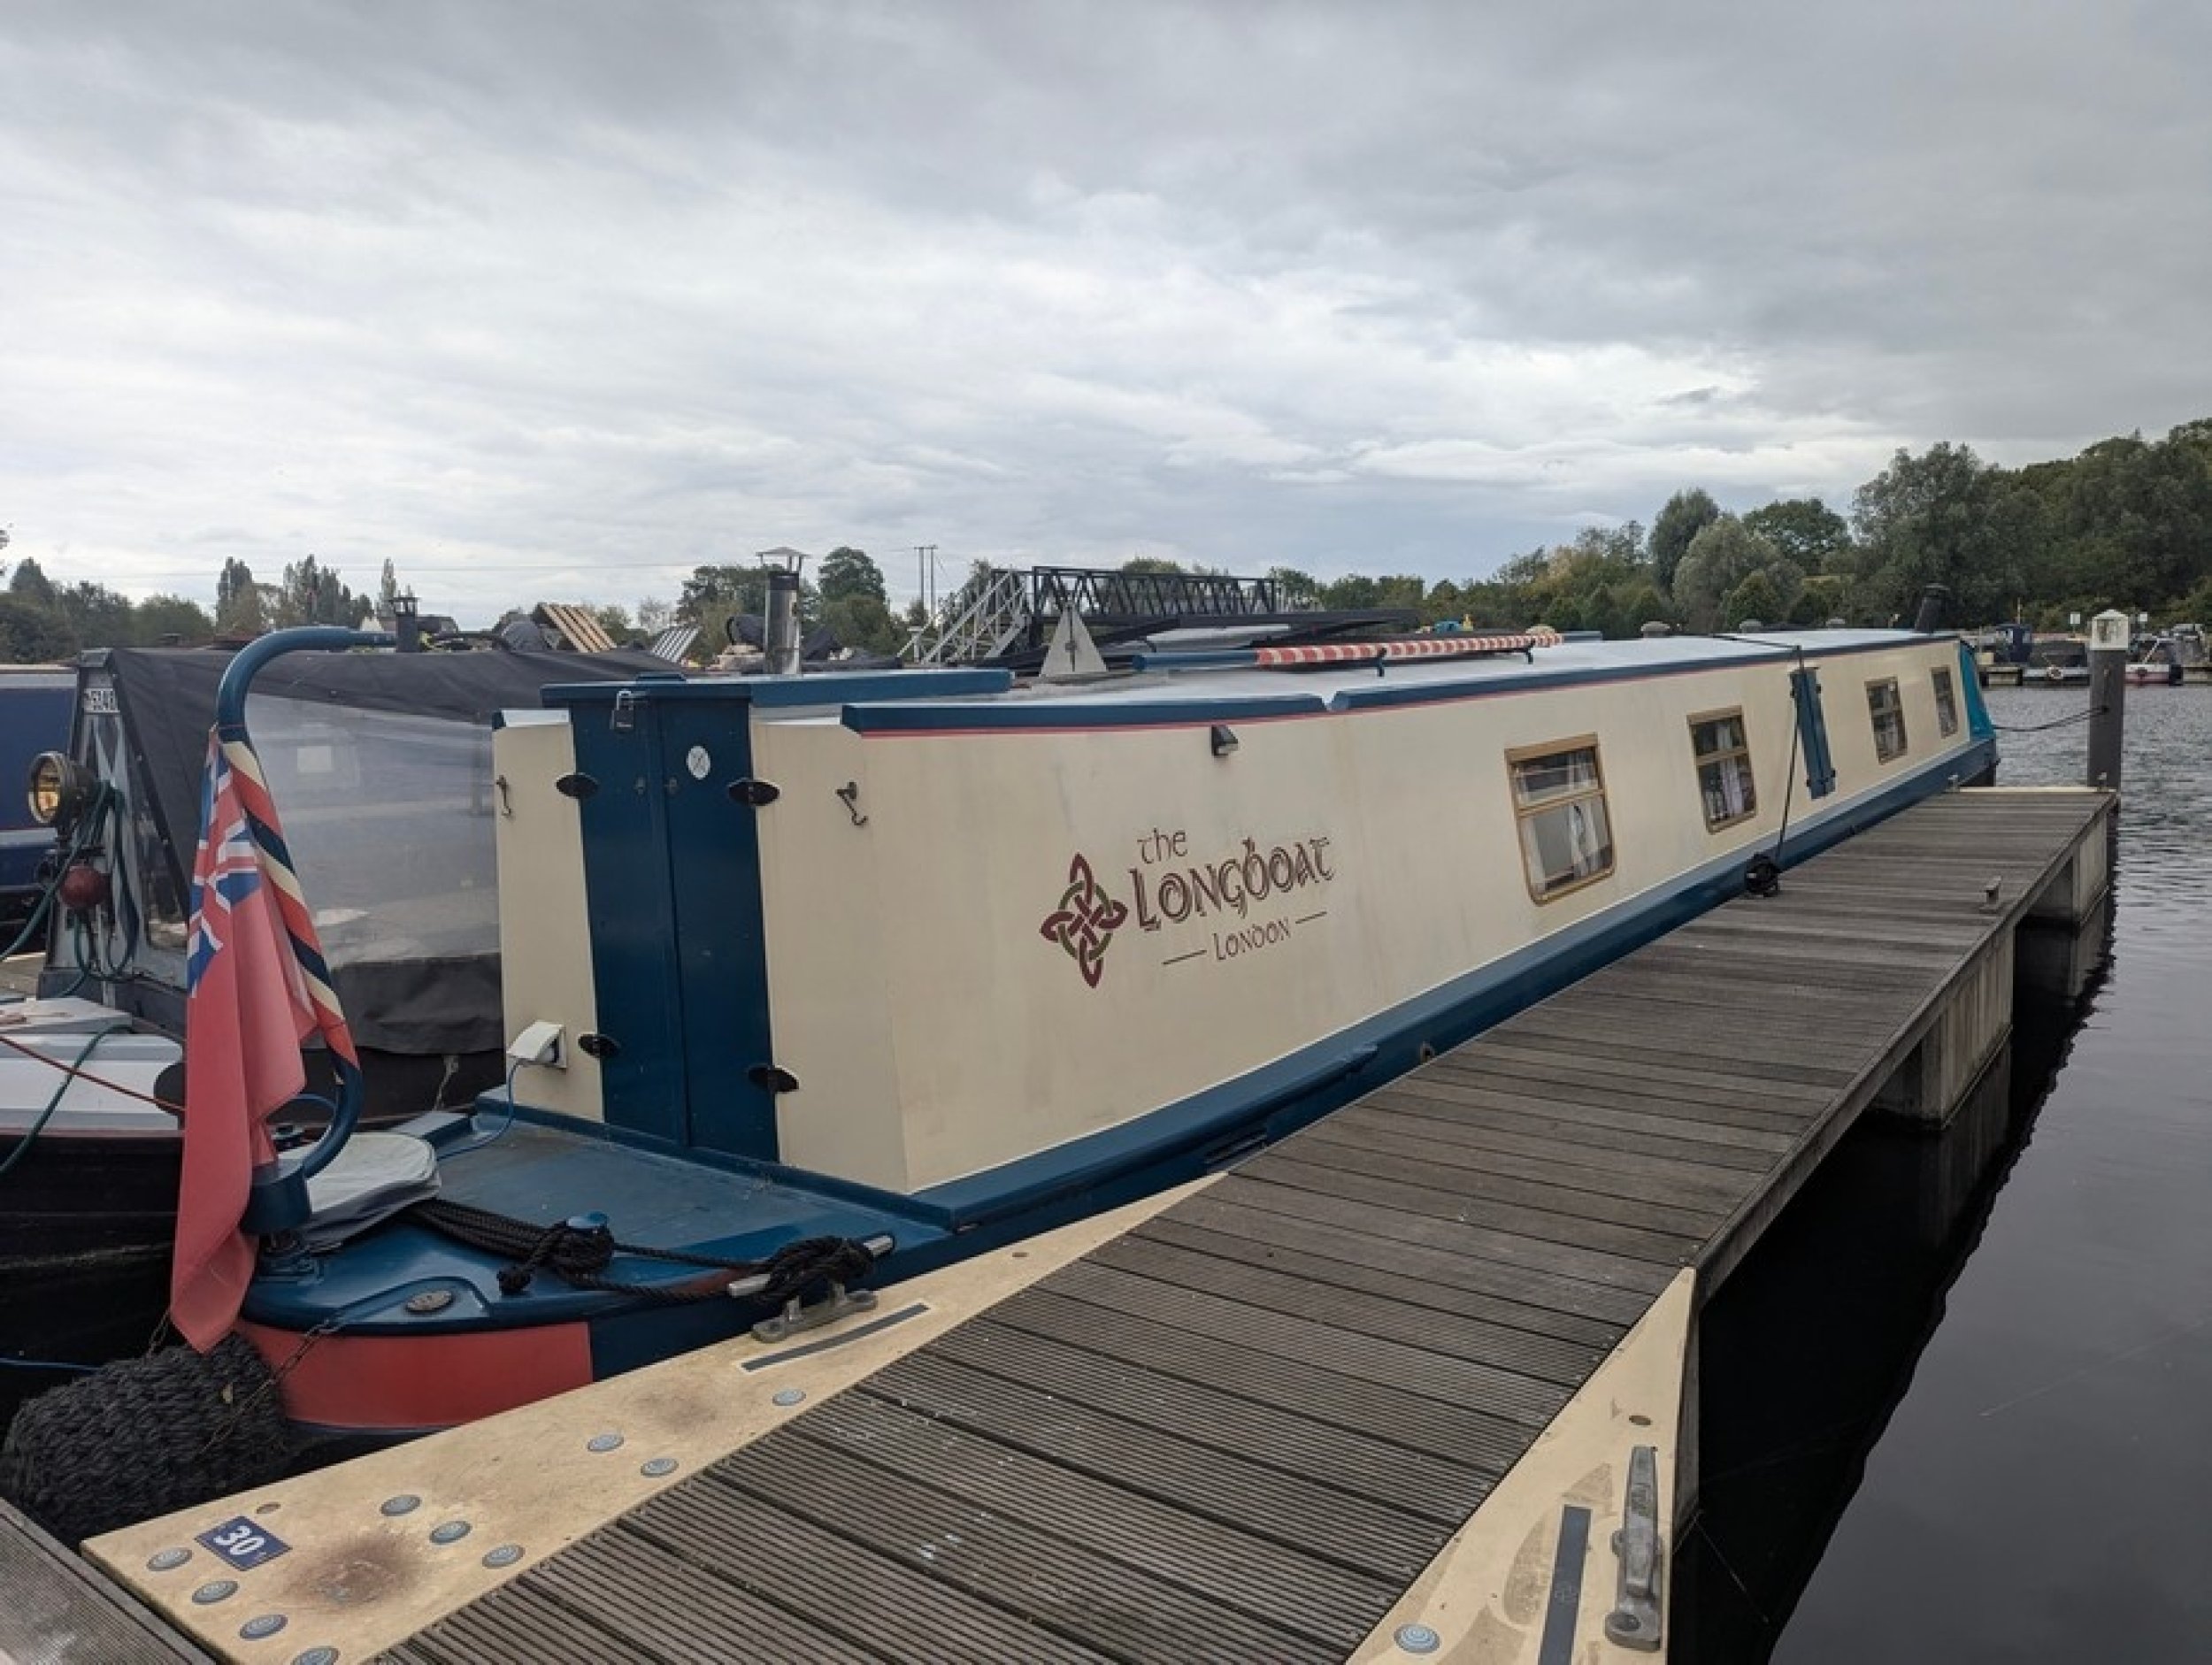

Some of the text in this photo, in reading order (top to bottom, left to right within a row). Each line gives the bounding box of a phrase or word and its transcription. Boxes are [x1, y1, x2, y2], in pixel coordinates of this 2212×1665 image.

[1137, 827, 1187, 863] the
[1213, 917, 1291, 960] LONDON
[213, 1525, 265, 1555] 30
